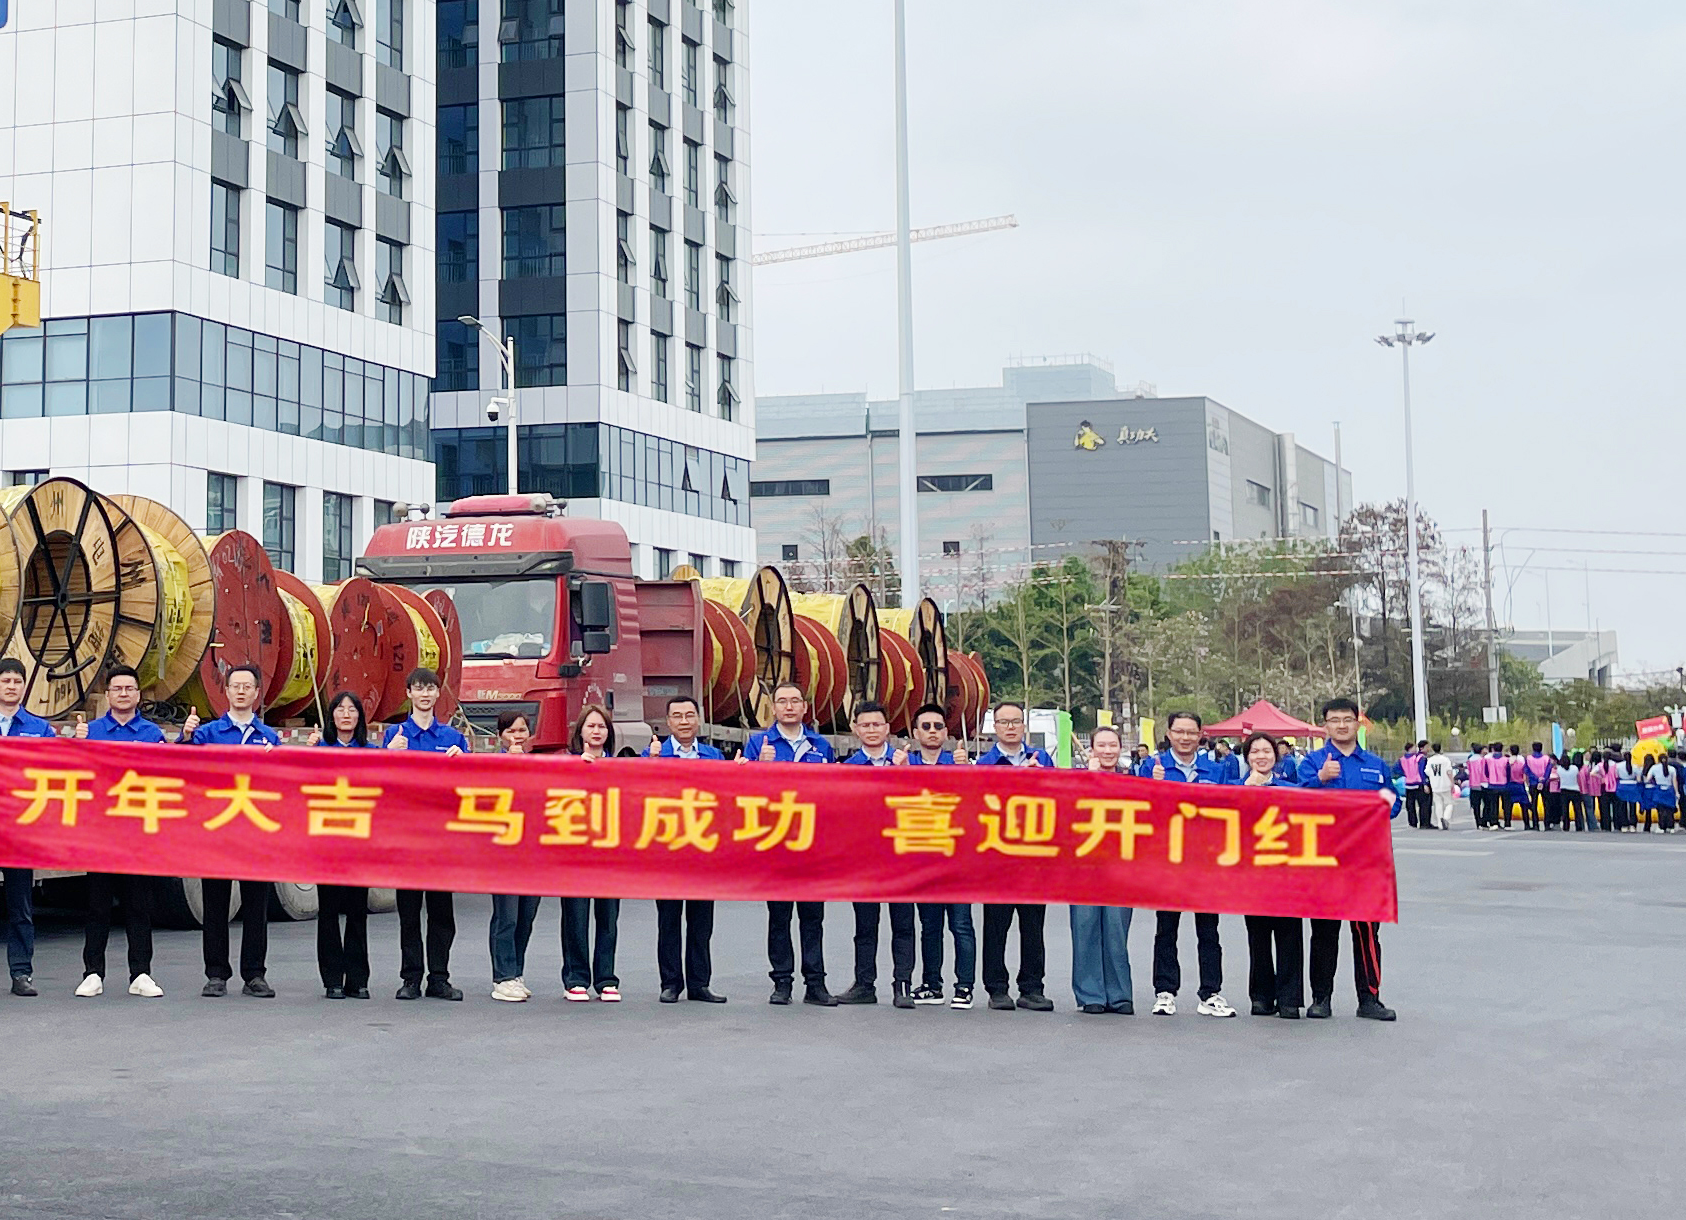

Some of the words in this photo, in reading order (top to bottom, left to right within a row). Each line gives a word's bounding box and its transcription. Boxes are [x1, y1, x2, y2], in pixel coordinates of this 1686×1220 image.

[1116, 425, 1159, 445] 真功夫
[405, 523, 515, 550] 陕汽德龙
[11, 767, 384, 839] 开年大吉
[445, 786, 816, 853] 马到成功
[882, 788, 1339, 868] 喜迎开门红
